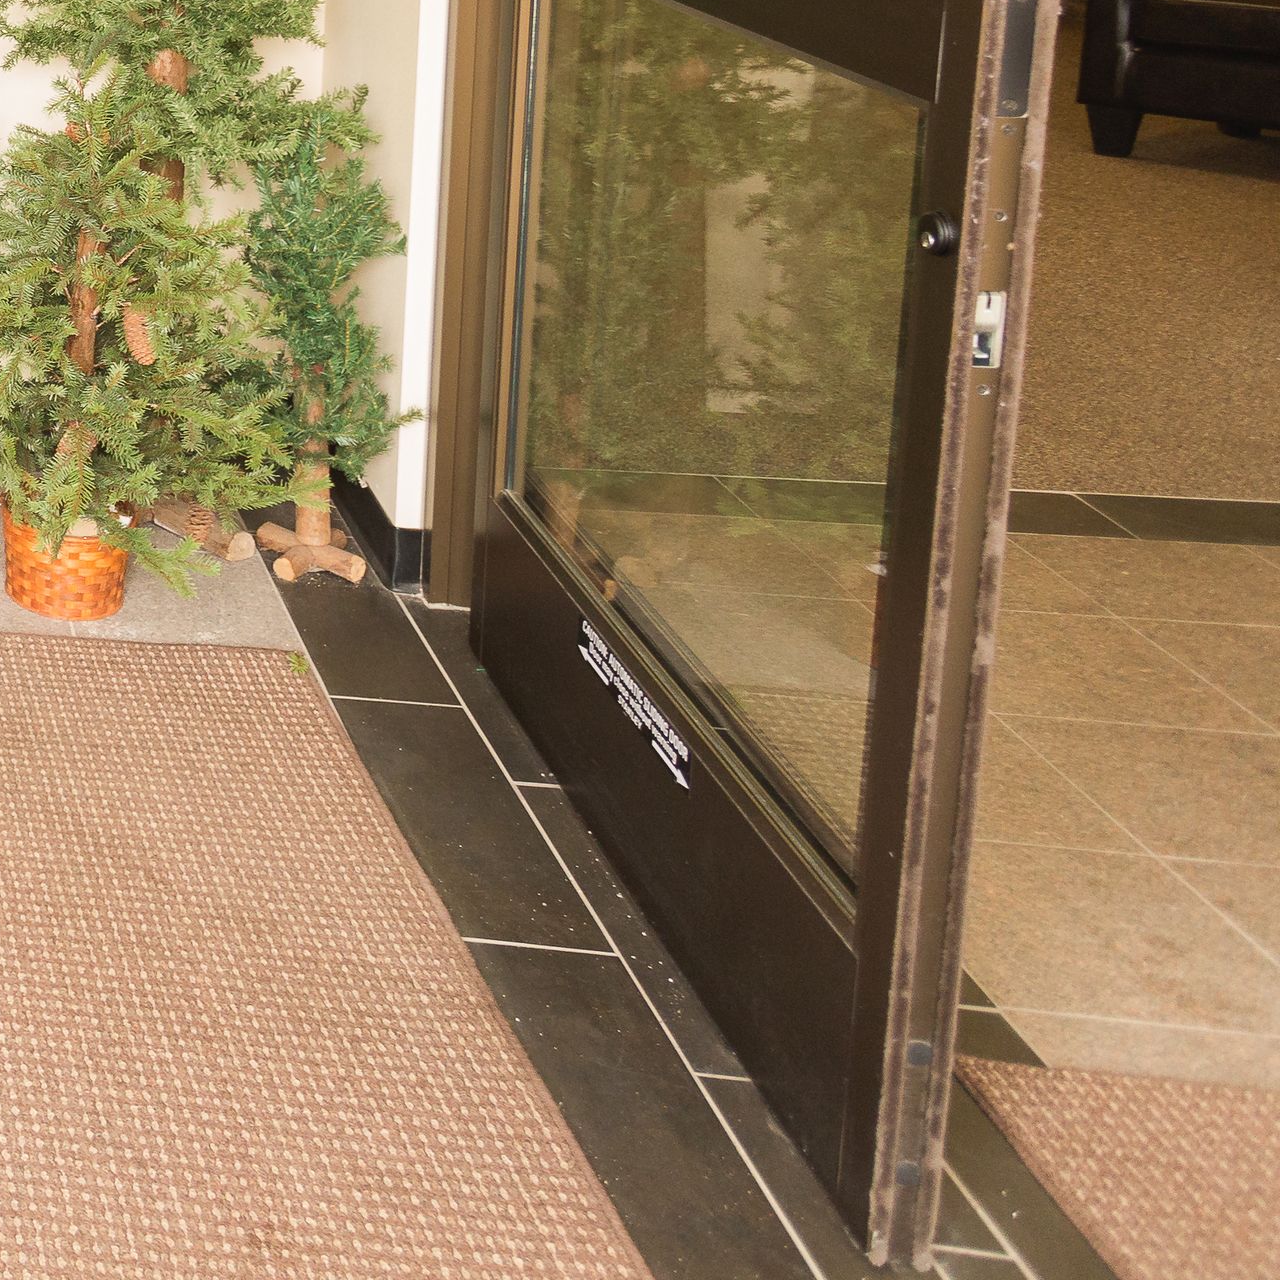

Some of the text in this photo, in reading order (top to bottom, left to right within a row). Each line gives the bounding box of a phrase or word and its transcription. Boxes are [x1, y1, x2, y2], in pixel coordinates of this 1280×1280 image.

[609, 653, 643, 704] AUTOMATIC
[643, 697, 669, 737] SLIDING
[669, 729, 688, 762] DOOR
